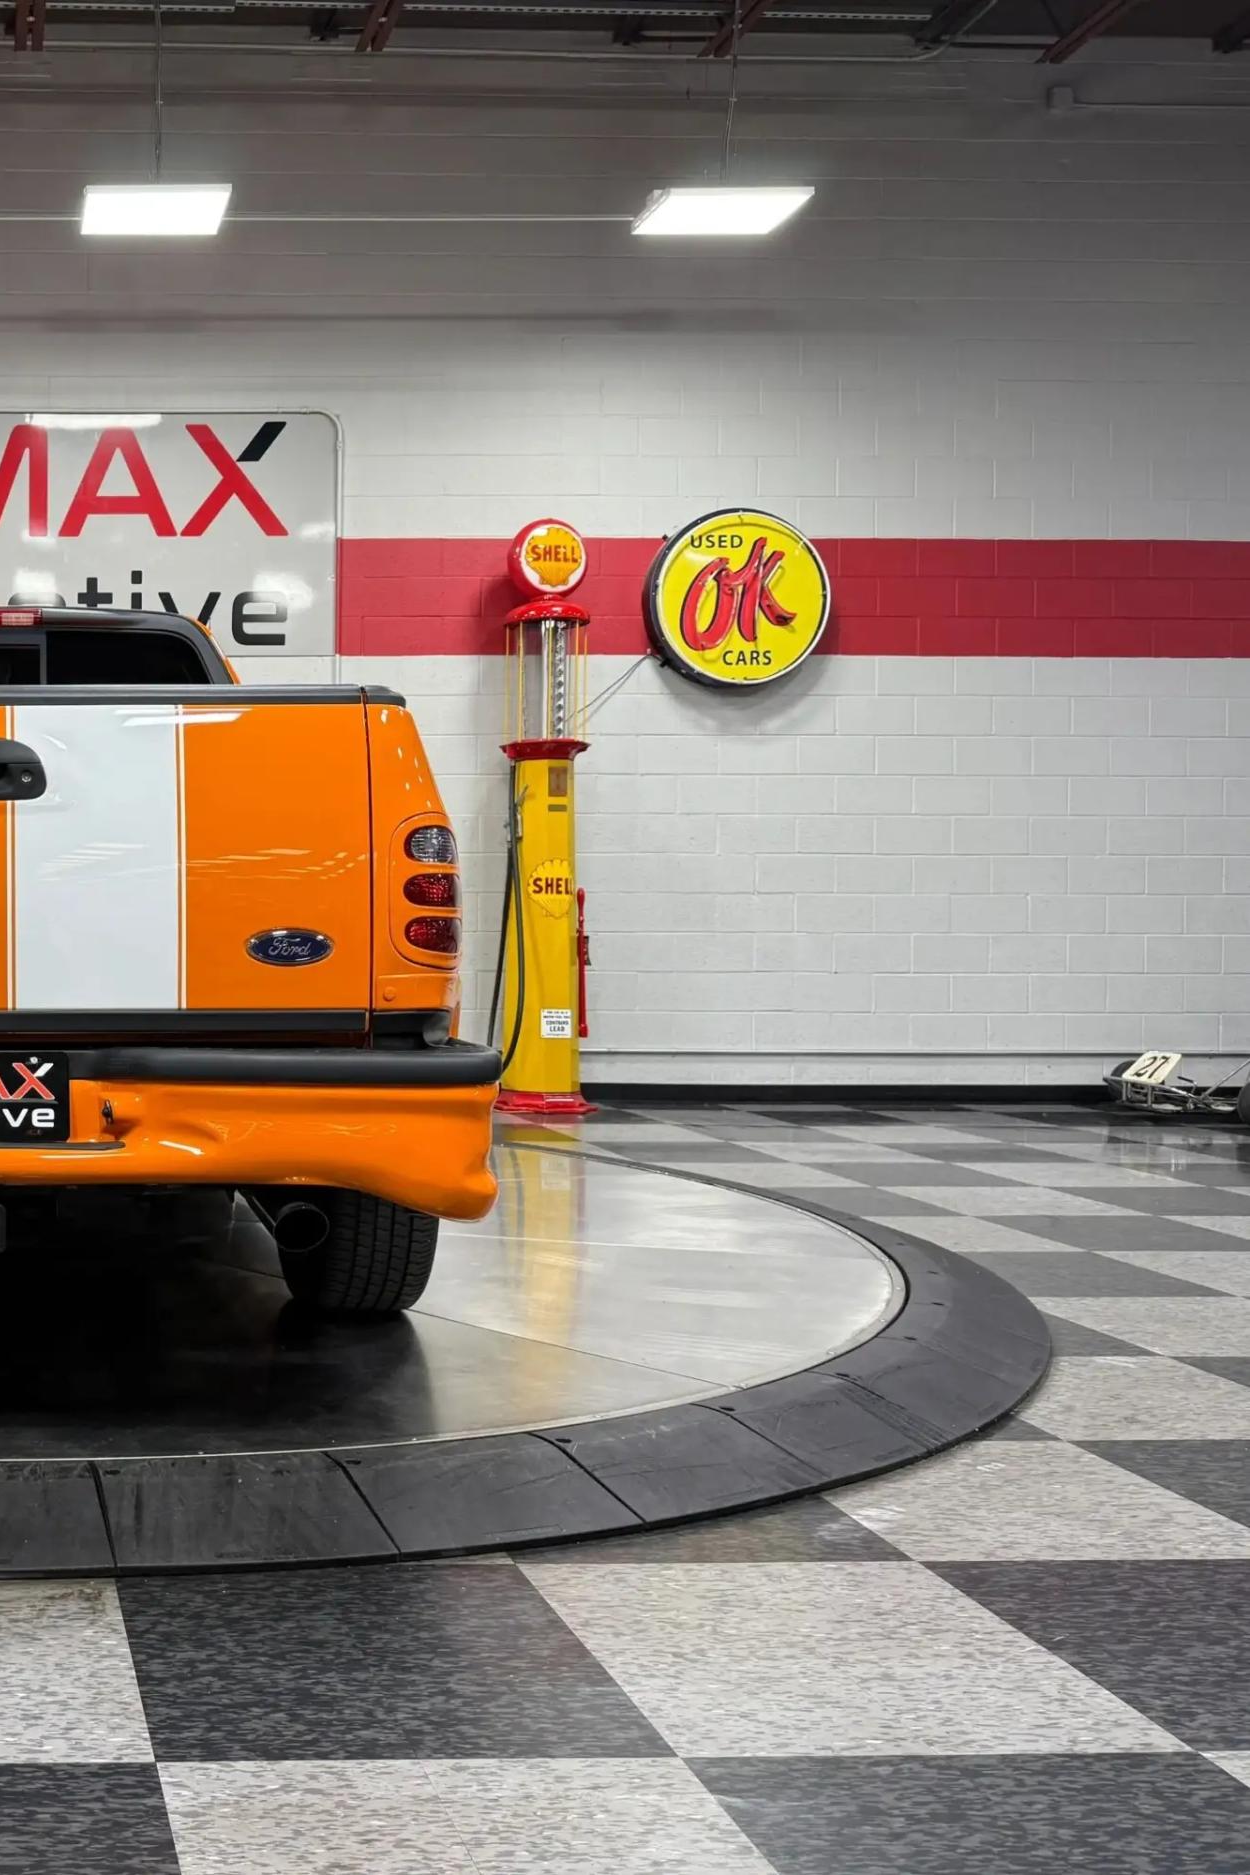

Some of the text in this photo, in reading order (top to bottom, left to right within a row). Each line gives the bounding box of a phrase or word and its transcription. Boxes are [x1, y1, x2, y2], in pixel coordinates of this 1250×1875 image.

[690, 534, 744, 549] USED
[530, 543, 579, 564] SHELL
[679, 537, 797, 651] OK
[722, 650, 773, 666] CARS
[268, 937, 312, 956] Ford
[1132, 1056, 1171, 1079] 27
